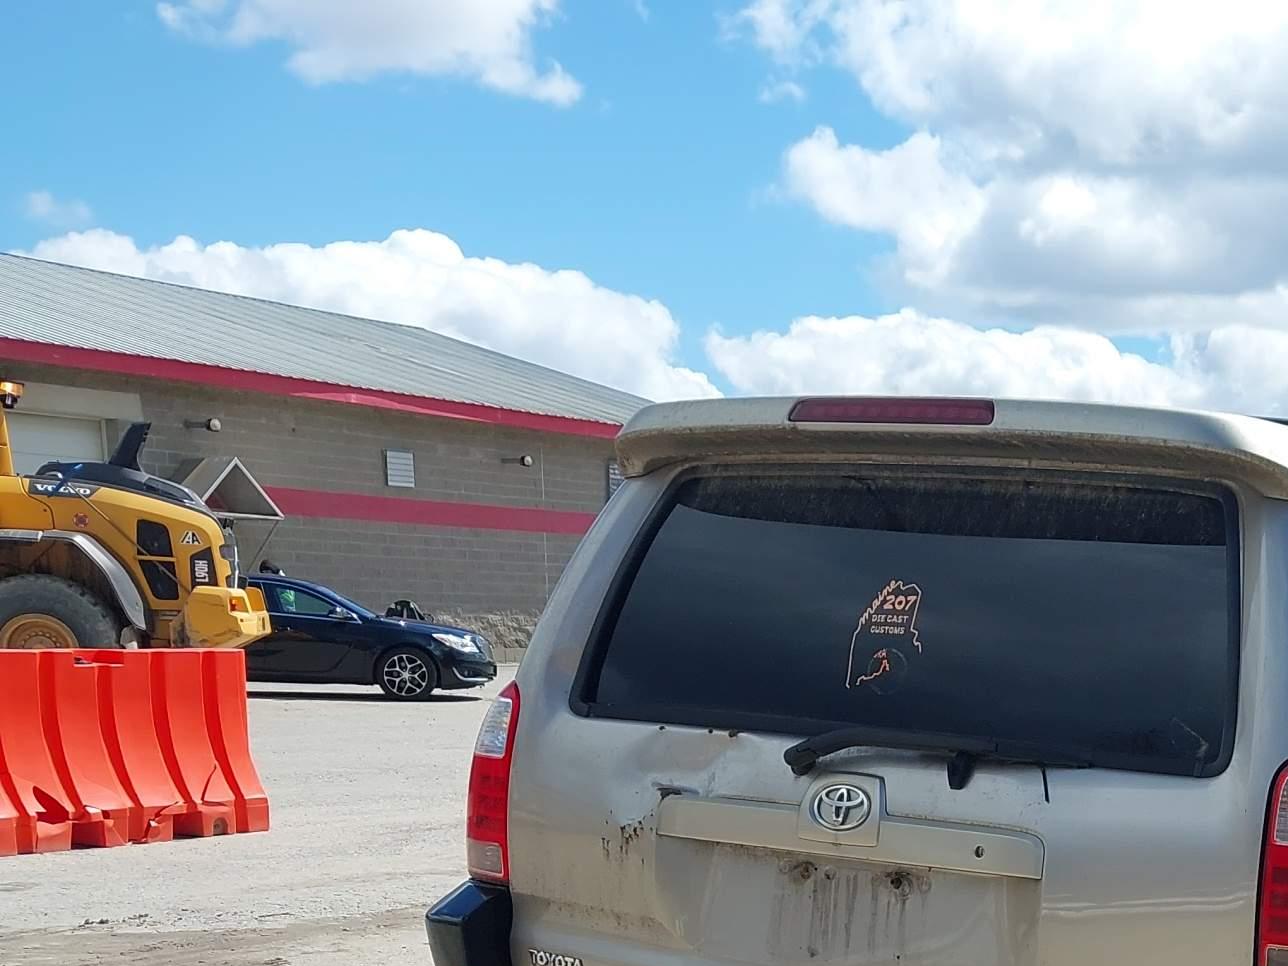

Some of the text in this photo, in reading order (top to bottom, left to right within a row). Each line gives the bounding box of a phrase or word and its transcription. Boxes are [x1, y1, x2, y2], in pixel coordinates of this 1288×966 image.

[194, 560, 209, 583] L90H
[883, 595, 917, 611] 207
[870, 625, 905, 635] CUSTOMS
